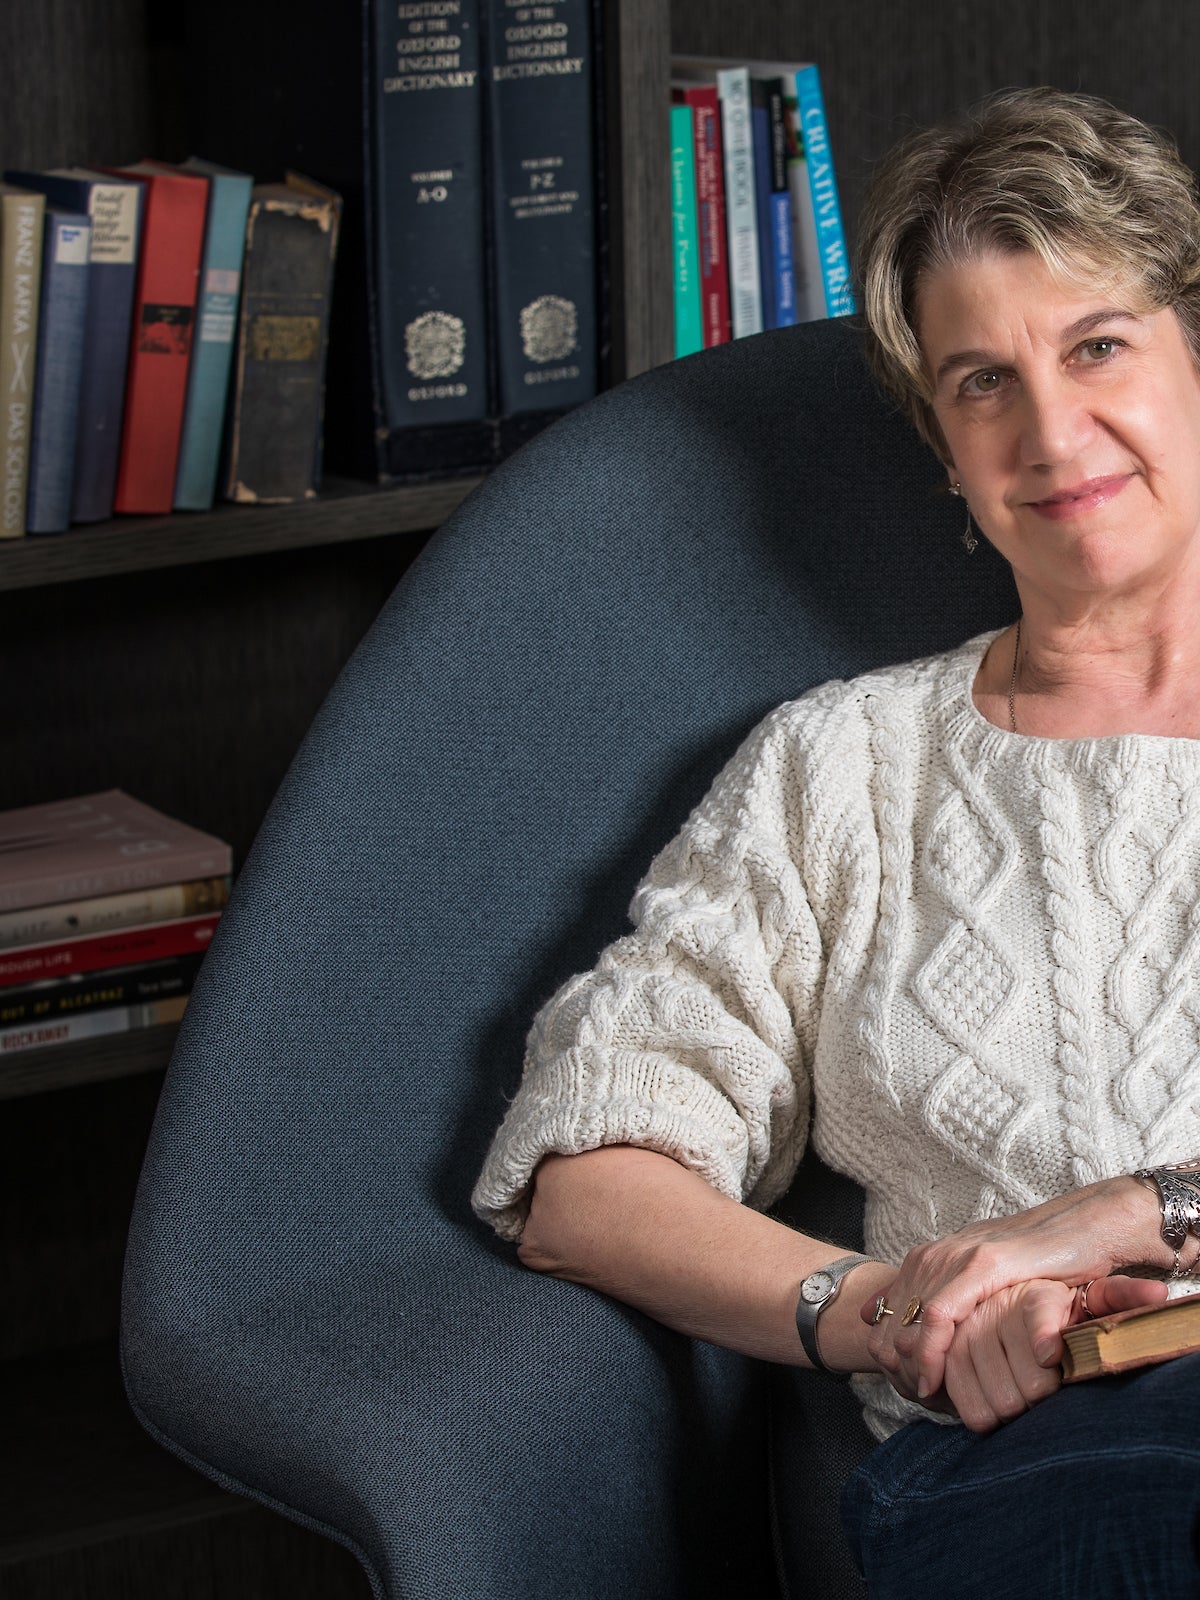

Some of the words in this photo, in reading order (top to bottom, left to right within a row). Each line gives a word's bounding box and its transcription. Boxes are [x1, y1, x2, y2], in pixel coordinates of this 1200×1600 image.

[398, 1, 460, 19] EDITION
[426, 19, 448, 32] THE
[505, 22, 568, 41] OXFORD
[397, 35, 461, 54] OXFORD
[506, 40, 567, 60] ENGLISH
[398, 53, 460, 72] ENGLISH
[492, 58, 584, 81] DICTIONARY
[383, 71, 477, 93] DICTIONARY
[805, 107, 839, 229] CREATIVE
[15, 205, 35, 266] FRANZ
[13, 274, 33, 335] KAFKA
[524, 366, 580, 385] OXFORD
[408, 383, 467, 401] OXFORD
[8, 402, 27, 441] DAS
[4, 445, 25, 530] SCHLOSS
[58, 985, 124, 1009] ALCATRAZ
[1, 1024, 70, 1050] ROCKAWAY
